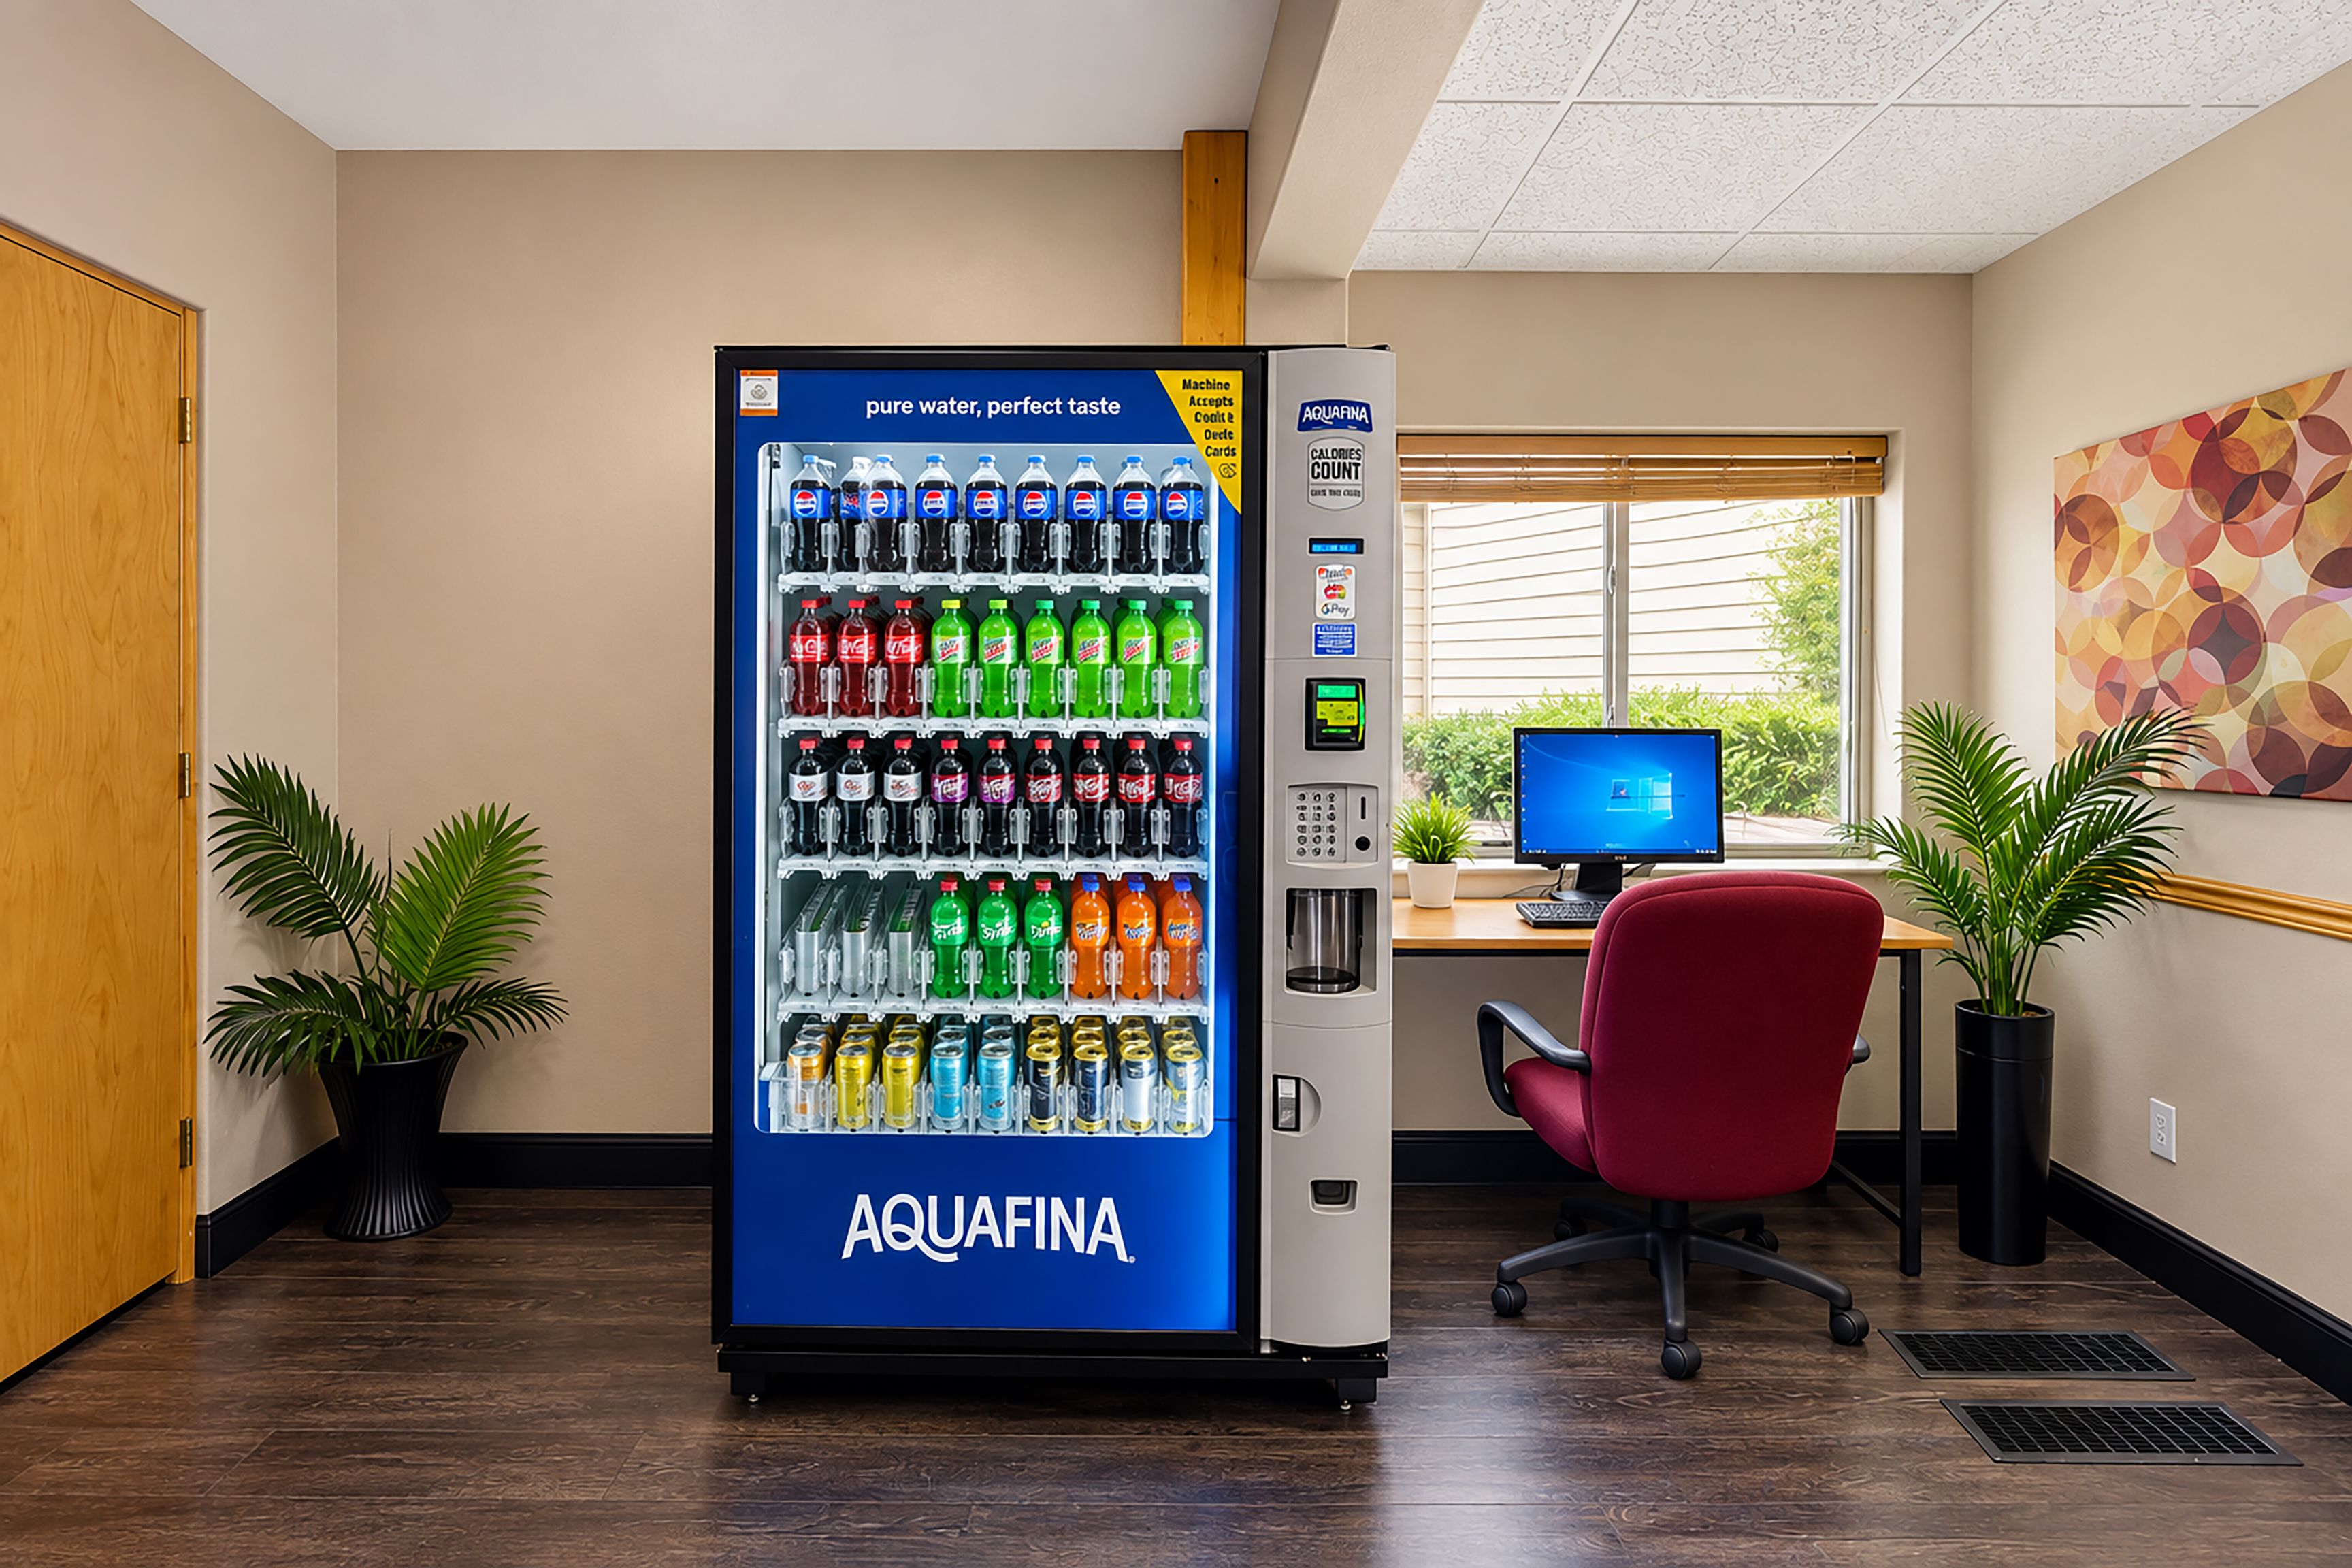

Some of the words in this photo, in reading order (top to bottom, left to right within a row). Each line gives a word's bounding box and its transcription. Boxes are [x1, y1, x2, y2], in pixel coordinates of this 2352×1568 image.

[1182, 378, 1230, 390] Machine
[866, 400, 913, 419] pure
[919, 397, 981, 418] water,
[987, 395, 1063, 419] perfect
[1067, 397, 1121, 414] taste
[1189, 395, 1234, 408] Accepts
[1205, 445, 1237, 457] Cards
[1311, 448, 1362, 460] CALORIES
[1311, 461, 1362, 480] COUNT
[841, 1194, 1128, 1262] AQUAFINA
